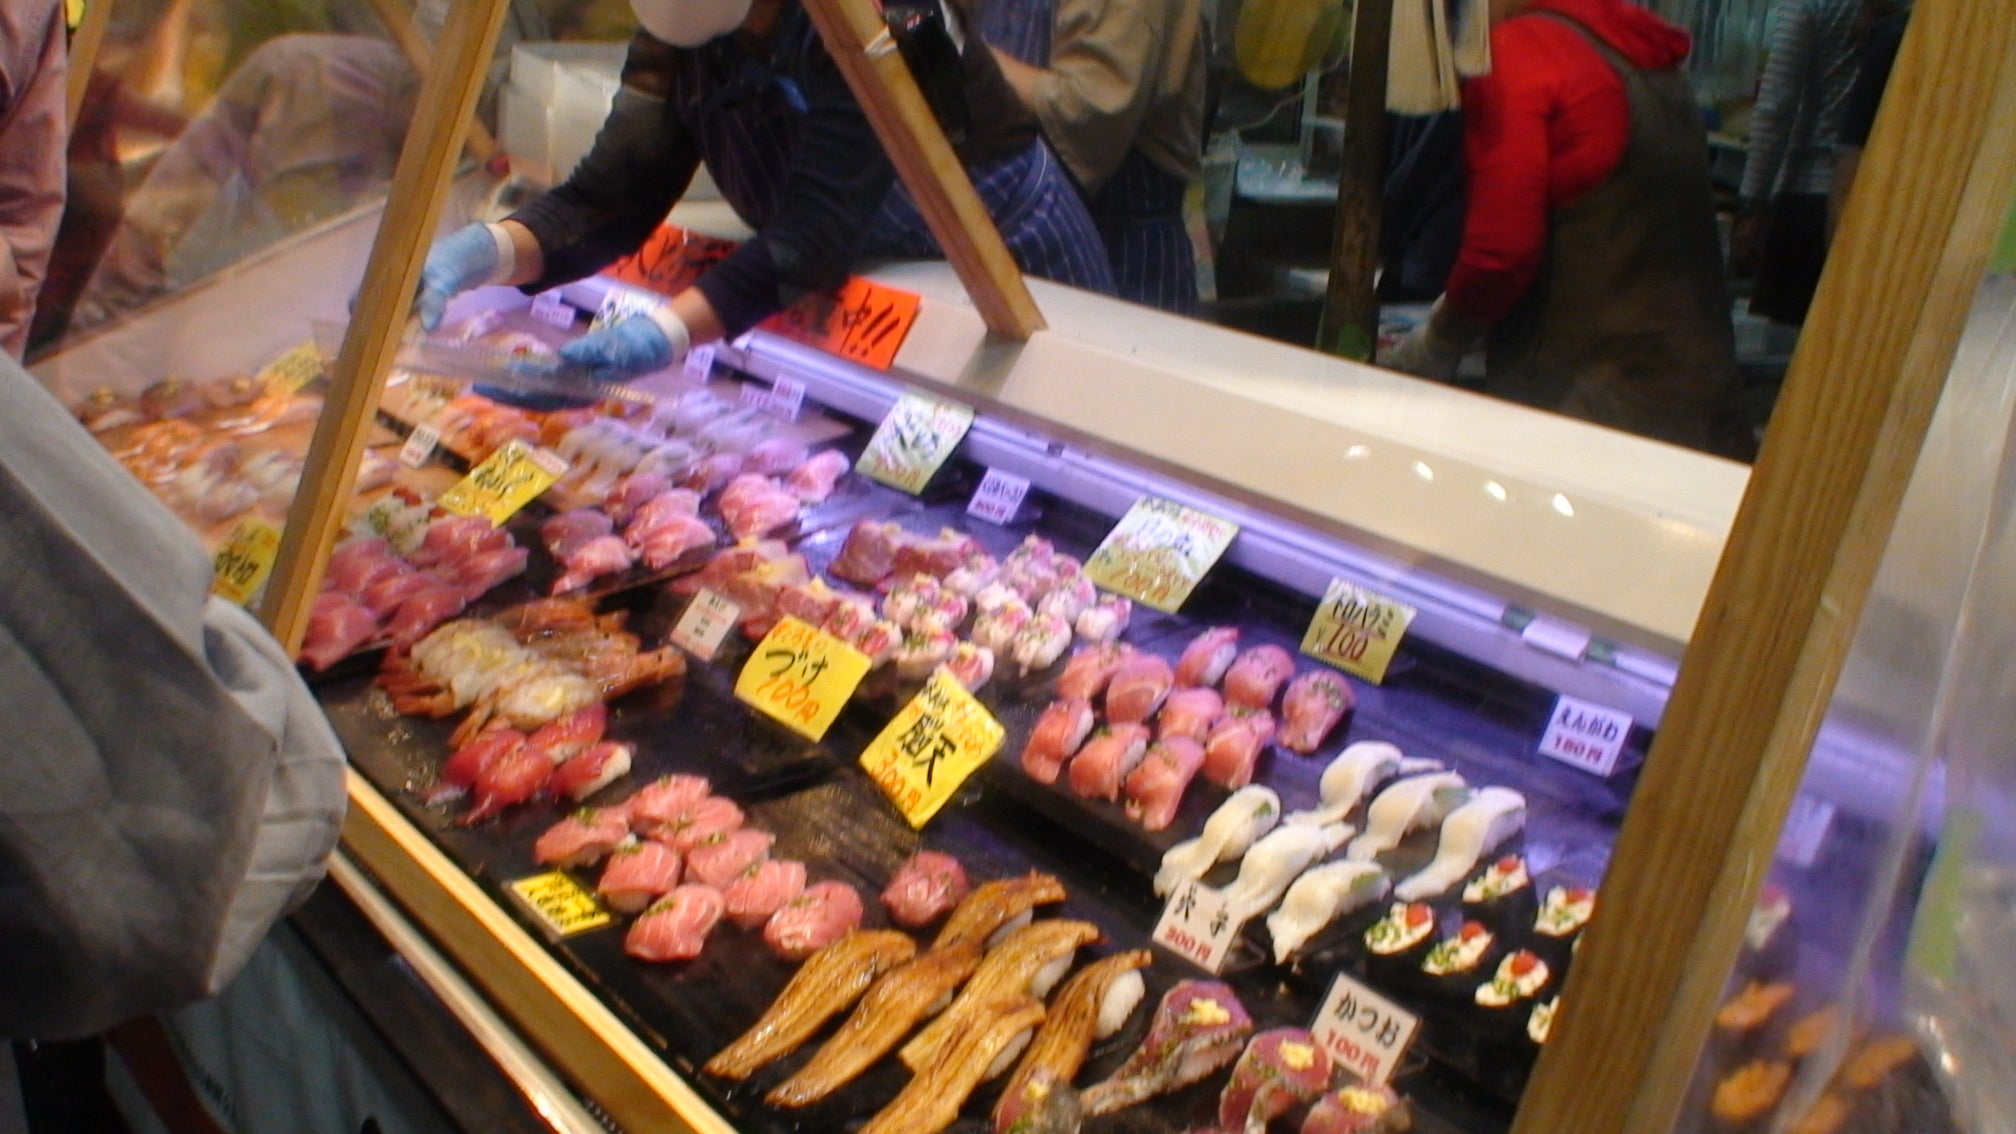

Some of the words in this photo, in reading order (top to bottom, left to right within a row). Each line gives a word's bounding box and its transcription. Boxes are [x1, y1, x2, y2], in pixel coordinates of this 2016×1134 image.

[765, 649, 829, 688] づけ
[1558, 705, 1619, 743] えんがわ
[1173, 882, 1230, 939] 穴子
[1332, 990, 1401, 1049] かつお
[1325, 1027, 1381, 1073] 100円
